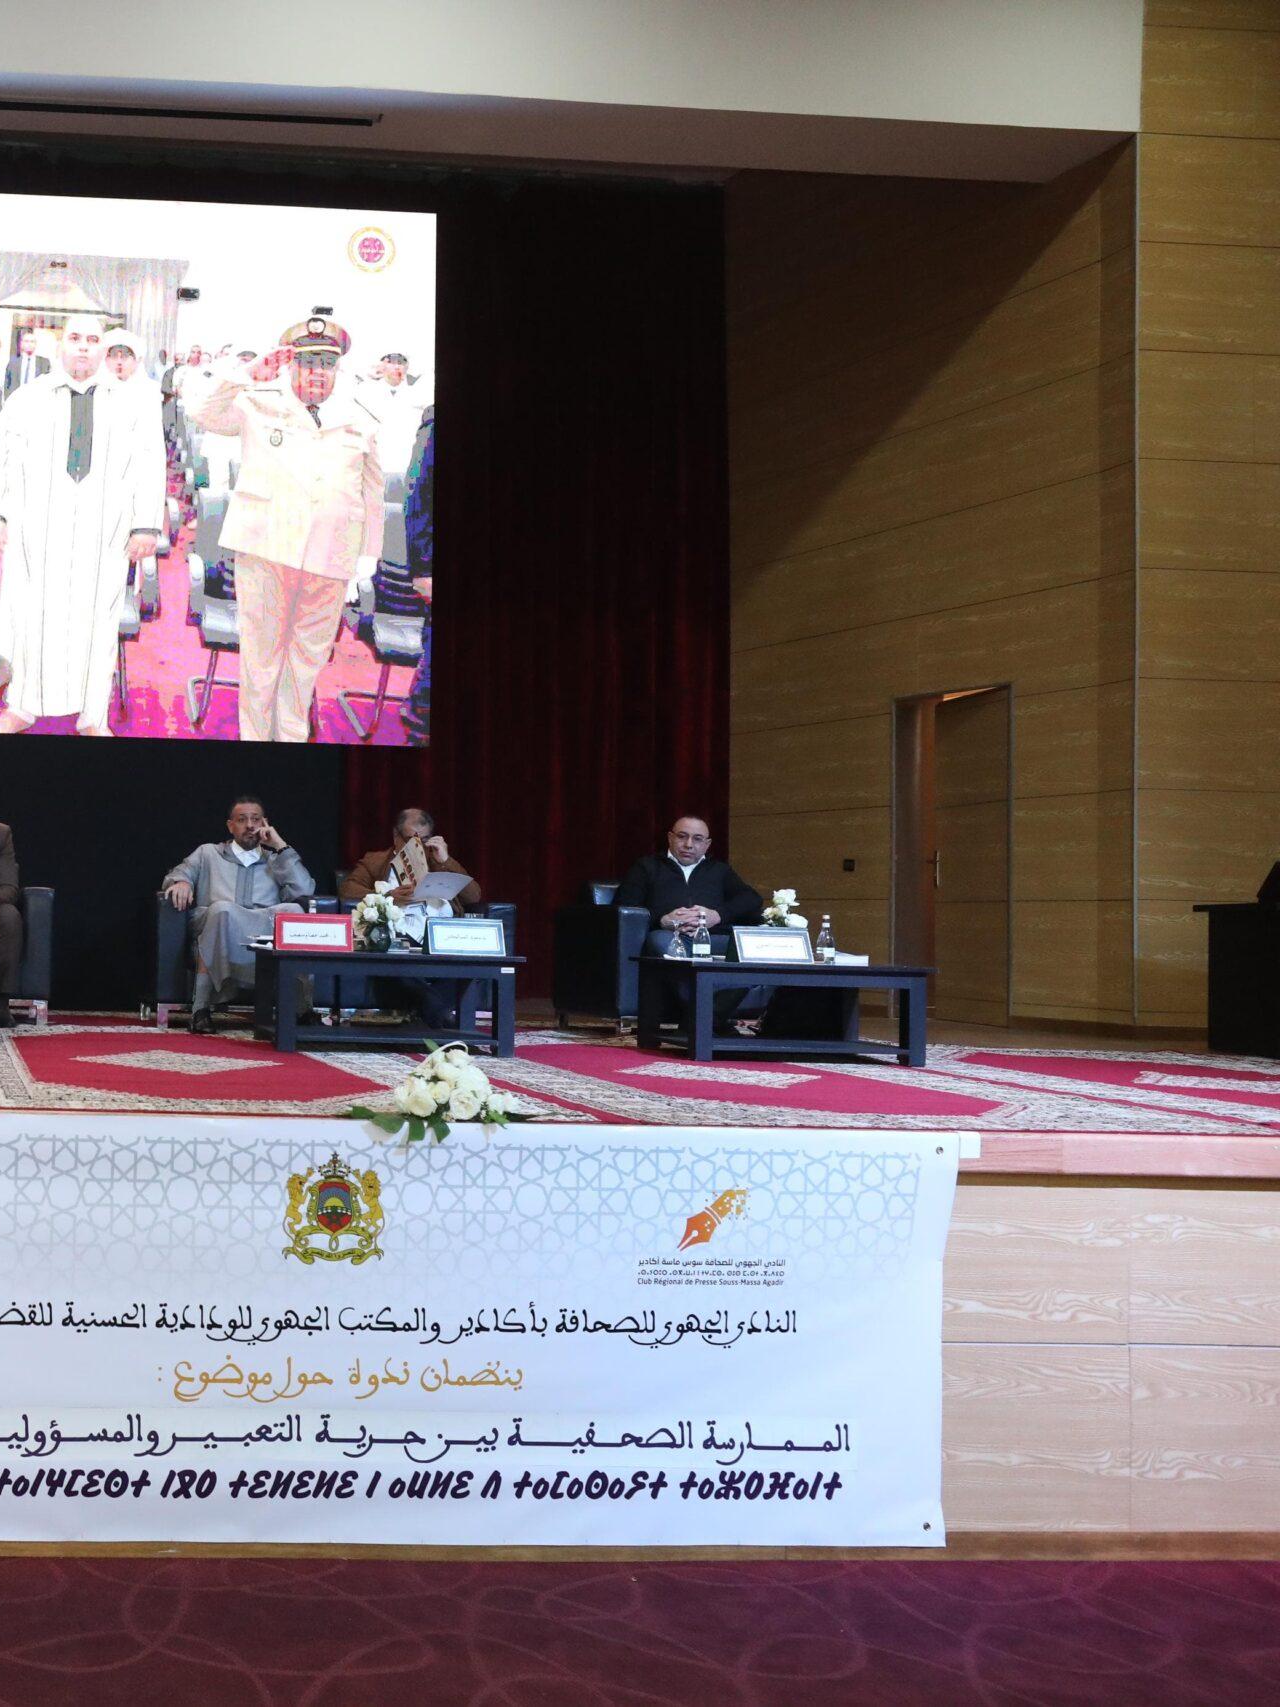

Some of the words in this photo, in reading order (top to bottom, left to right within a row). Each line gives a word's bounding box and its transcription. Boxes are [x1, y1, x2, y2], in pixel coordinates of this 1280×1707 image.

[661, 1258, 680, 1266] ماسة
[682, 1260, 703, 1268] سوس
[705, 1258, 733, 1266] للصحافة
[735, 1258, 762, 1268] الجهوي
[764, 1259, 786, 1268] النادي
[695, 1278, 717, 1286] Presse
[719, 1278, 761, 1286] Souss-Massa
[762, 1279, 784, 1287] Agadir
[61, 1301, 147, 1333] الحسنية
[155, 1303, 252, 1342] للودادية
[224, 1306, 330, 1346] الجهوي
[338, 1306, 441, 1344] والمكتب
[438, 1301, 548, 1344] بأكادير
[554, 1308, 656, 1334] للصحافة
[628, 1310, 729, 1349] الجهوي
[702, 1309, 797, 1349] النادي
[173, 1354, 272, 1402] موضوع
[247, 1356, 334, 1403] حول
[348, 1357, 410, 1399] ندوة
[420, 1358, 524, 1392] ينظمان
[147, 1414, 302, 1456] التعبير
[315, 1414, 426, 1458] حرية
[404, 1427, 499, 1463] بين
[506, 1417, 694, 1454] الصحفية
[703, 1420, 851, 1466] الممارسة
